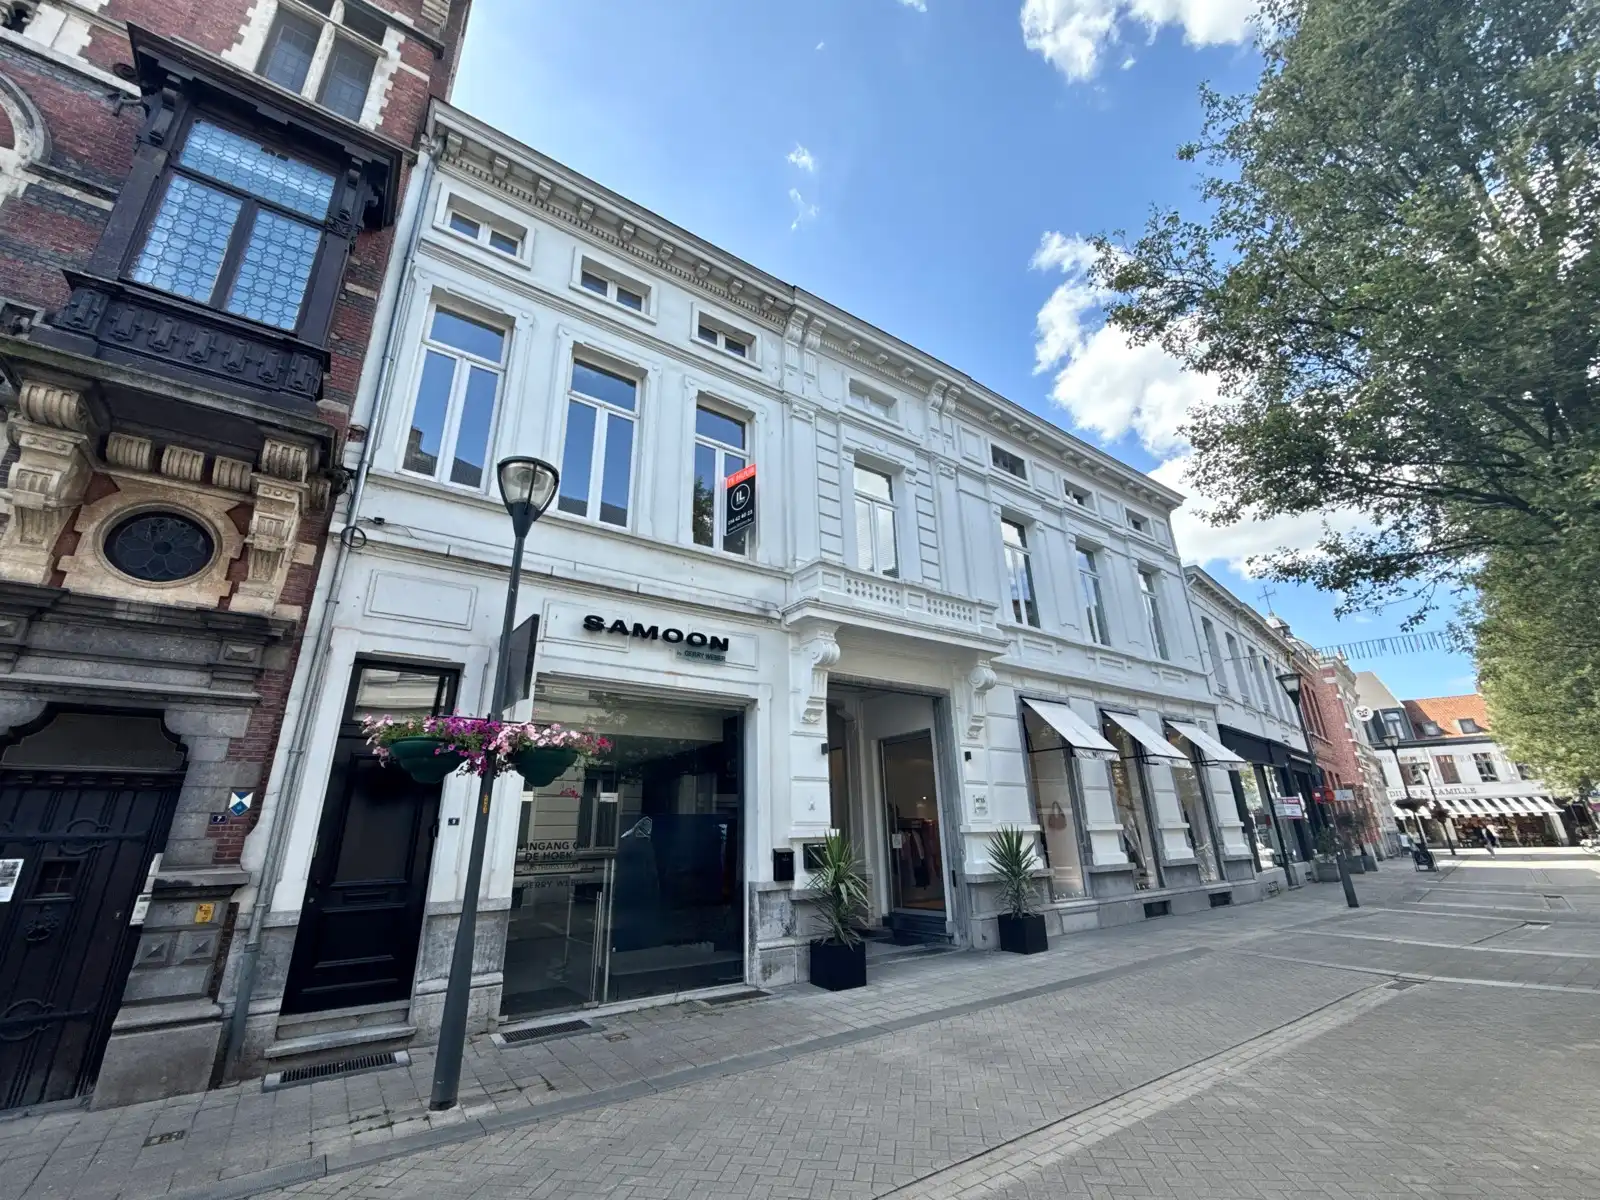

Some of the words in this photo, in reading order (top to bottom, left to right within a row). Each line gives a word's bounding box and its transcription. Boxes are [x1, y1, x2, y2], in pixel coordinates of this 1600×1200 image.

[583, 614, 730, 652] SAMOON
[684, 650, 704, 659] GERRY
[705, 653, 726, 662] WEBER
[1388, 789, 1417, 798] DILE
[525, 852, 539, 861] DE
[543, 851, 573, 860] HOEK
